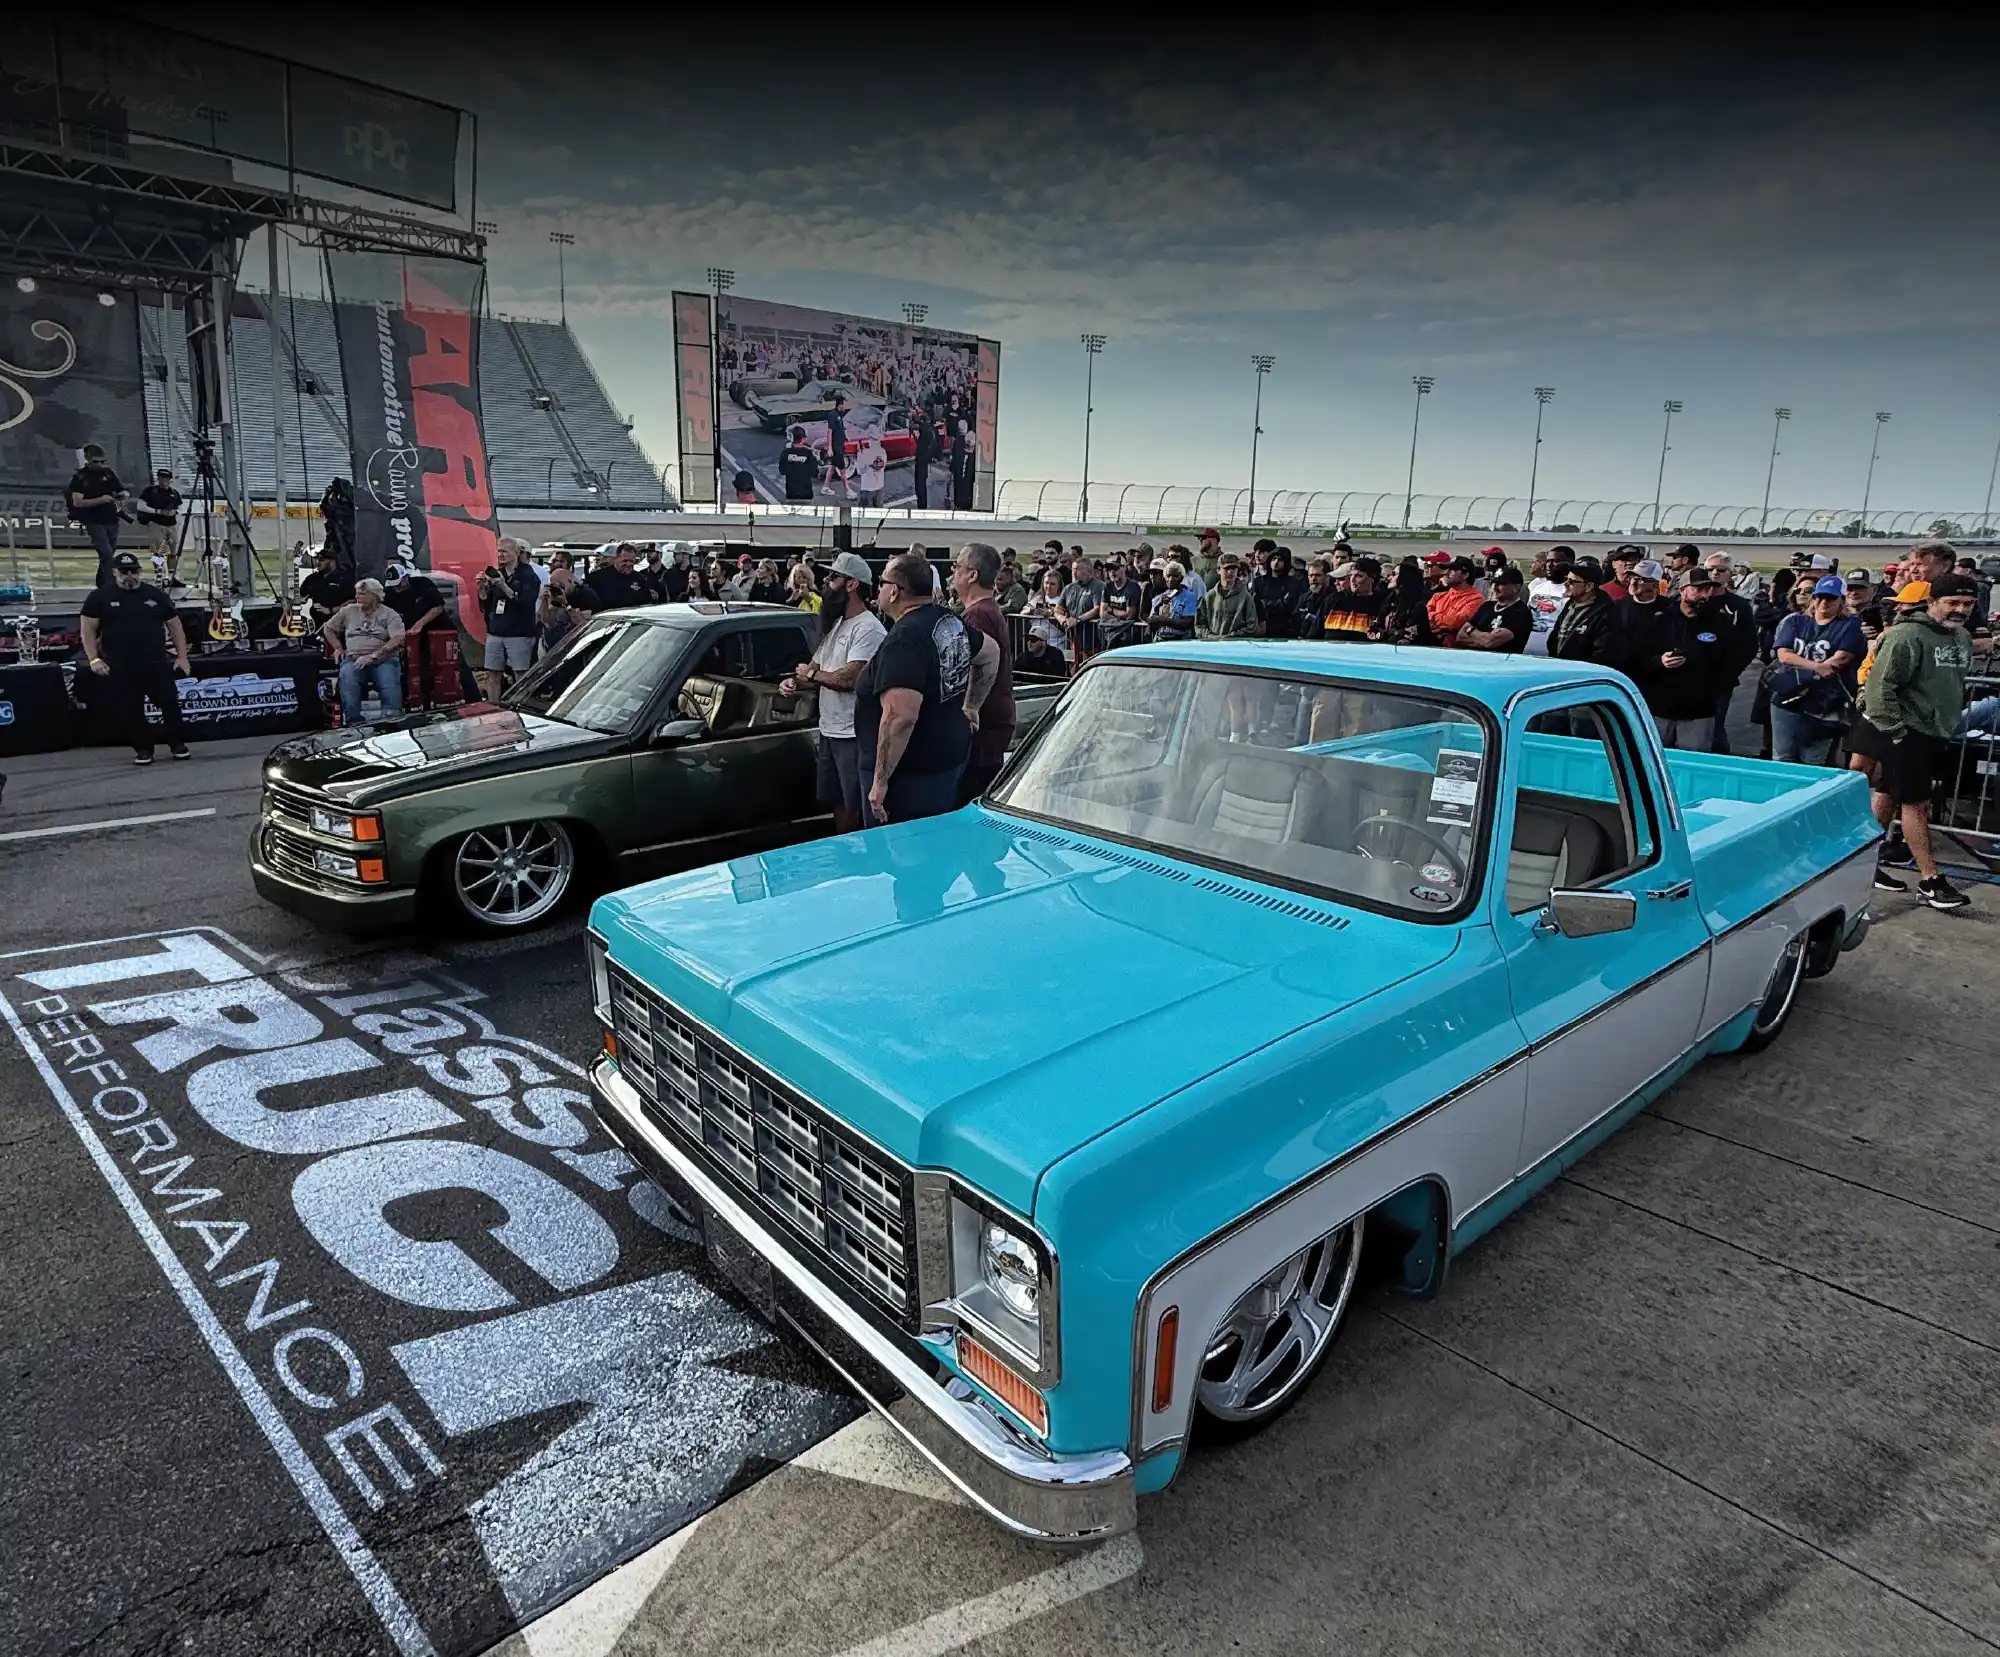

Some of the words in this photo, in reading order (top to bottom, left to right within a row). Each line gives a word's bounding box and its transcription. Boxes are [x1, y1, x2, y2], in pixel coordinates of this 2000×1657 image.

[343, 121, 408, 171] PPG
[375, 299, 406, 447] automotive
[681, 303, 710, 443] ARP
[977, 345, 997, 465] ARP
[366, 442, 419, 512] Racing
[404, 256, 500, 647] ARP
[1306, 529, 1326, 538] ZONE
[184, 698, 228, 710] CROWN
[230, 697, 246, 707] OF
[248, 692, 298, 705] RODDING
[15, 933, 869, 1629] TRUCK
[22, 994, 447, 1512] PERFORMANCE
